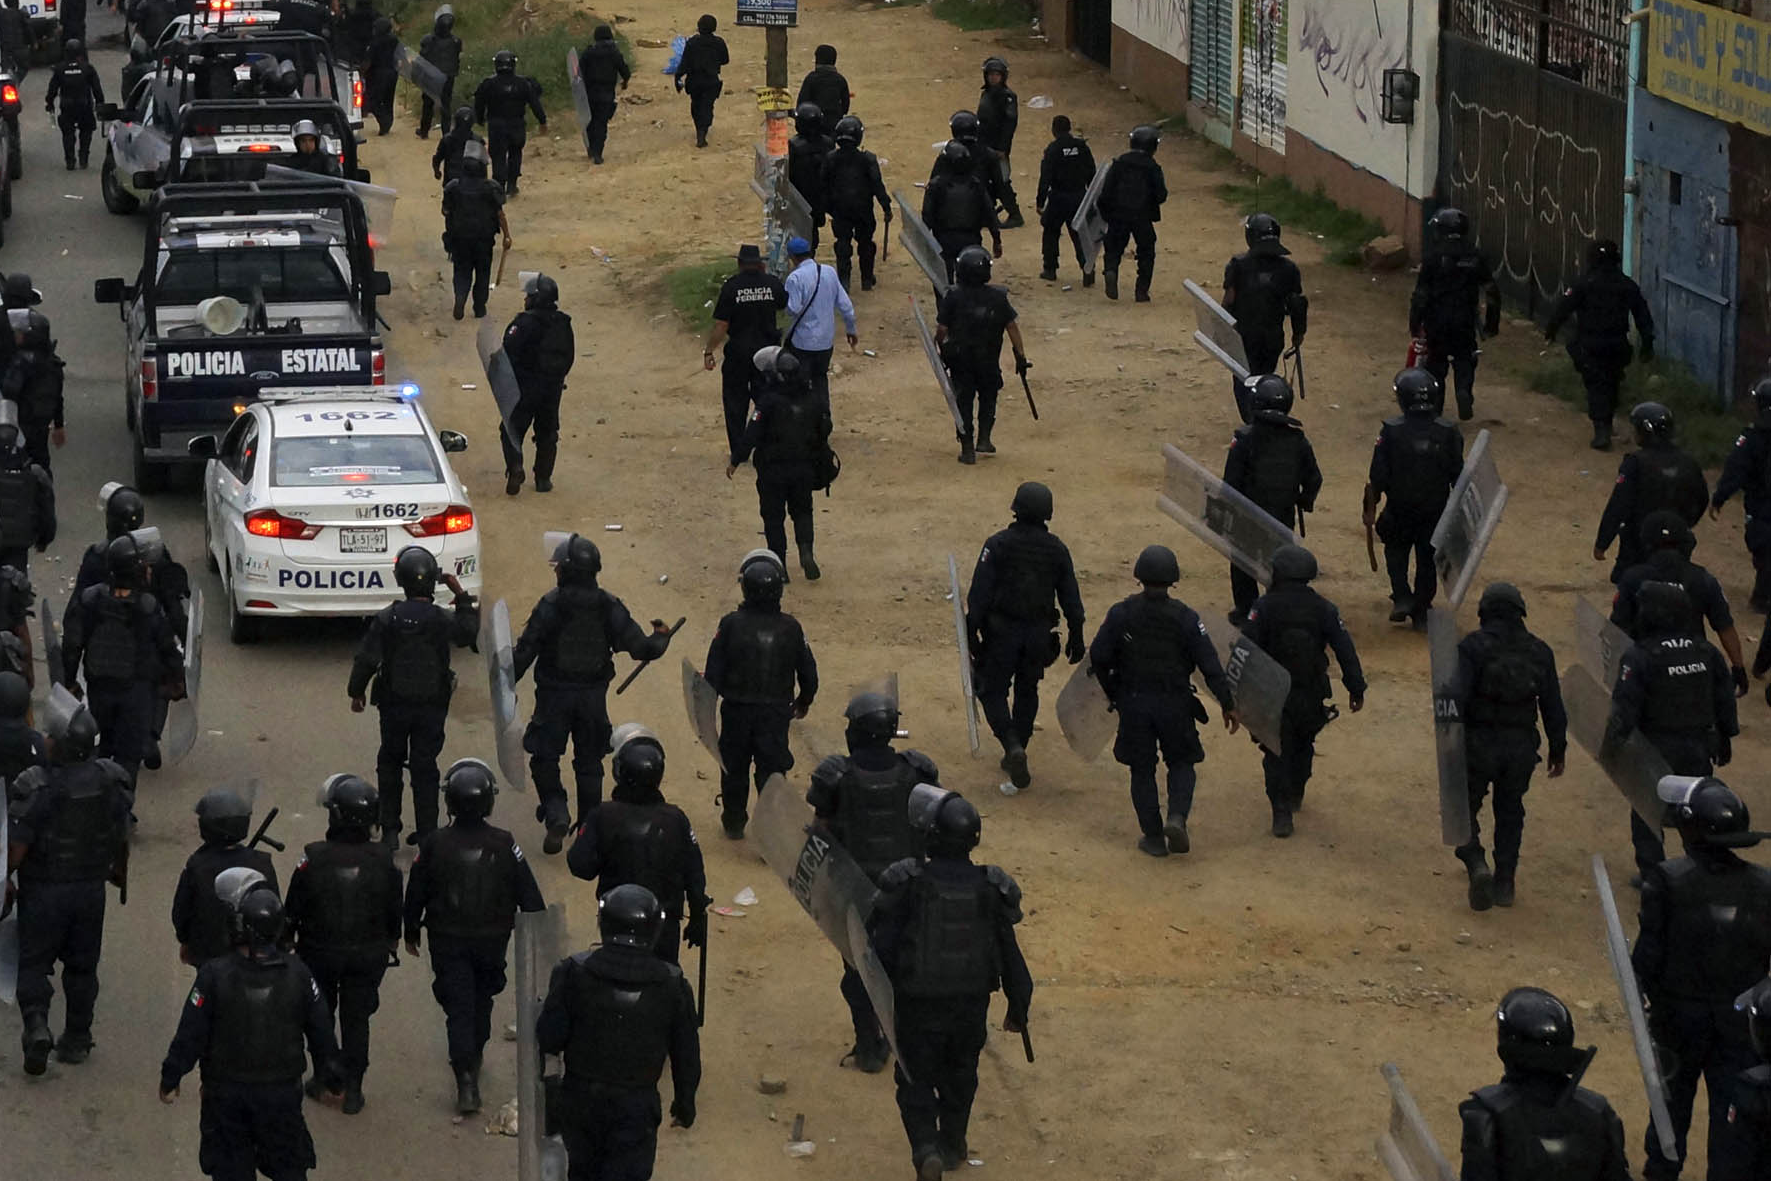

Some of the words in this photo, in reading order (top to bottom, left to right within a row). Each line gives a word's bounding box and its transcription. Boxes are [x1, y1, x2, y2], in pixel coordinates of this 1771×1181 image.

[167, 351, 246, 376] POLICIA
[281, 348, 361, 373] ESTATAL
[295, 411, 398, 422] 1662
[371, 503, 419, 519] 1662
[278, 569, 384, 589] POLICIA
[1668, 662, 1707, 677] POLICIA
